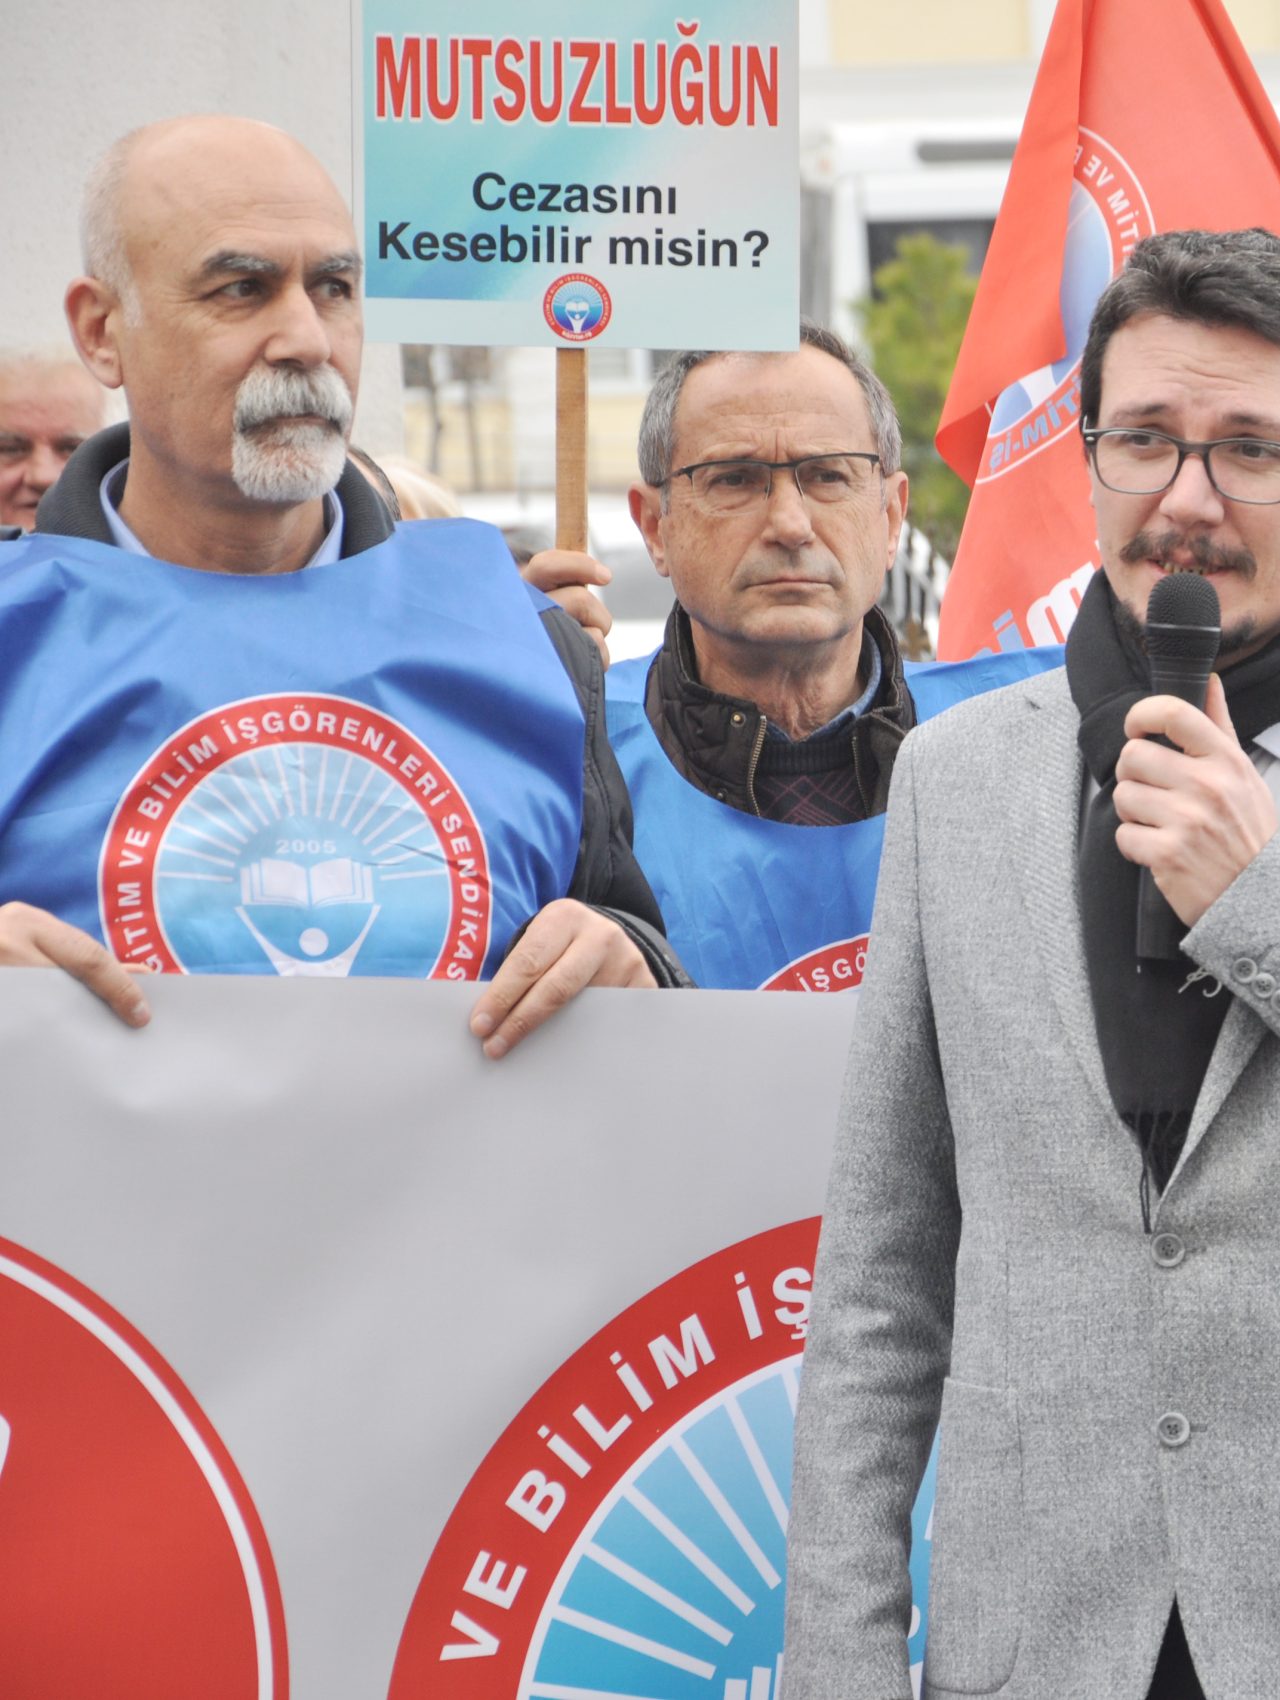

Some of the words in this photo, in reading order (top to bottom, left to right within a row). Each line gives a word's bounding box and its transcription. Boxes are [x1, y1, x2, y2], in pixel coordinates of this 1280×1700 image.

[375, 22, 779, 127] MUTSUZLUĞUN
[472, 172, 677, 215] Cezasını
[378, 221, 592, 264] Kesebilir
[609, 229, 770, 268] misin?
[118, 827, 151, 869] VE
[138, 735, 219, 821] BİLİM
[220, 704, 452, 807] İŞGÖRENLERİ
[441, 812, 482, 981] SENDİKAS
[275, 839, 336, 855] 2005
[439, 1549, 528, 1661] VE
[505, 1313, 716, 1533] BİLİM
